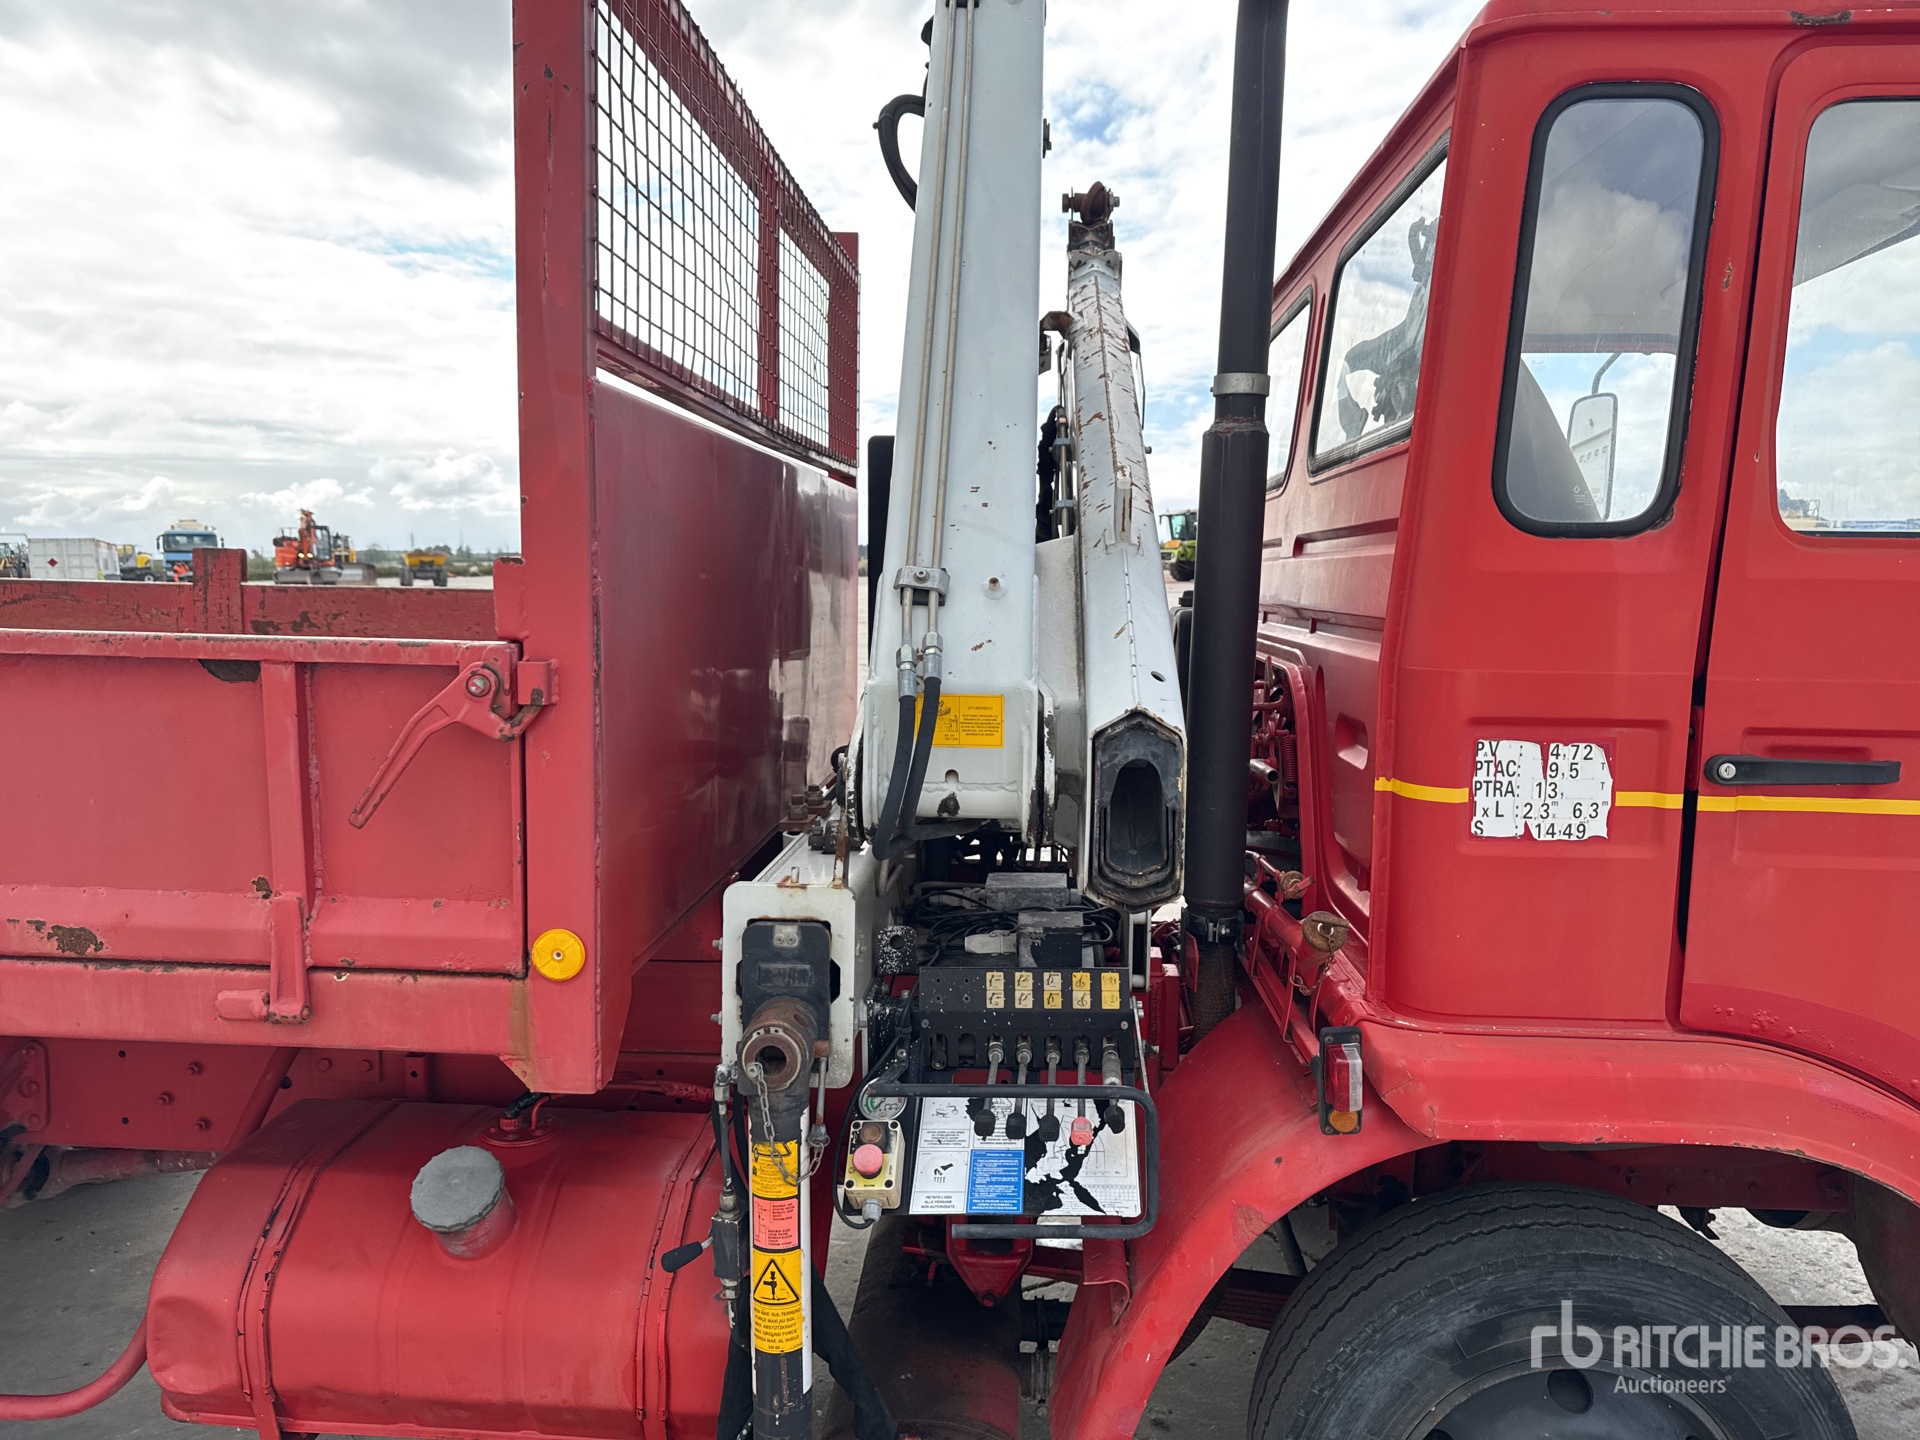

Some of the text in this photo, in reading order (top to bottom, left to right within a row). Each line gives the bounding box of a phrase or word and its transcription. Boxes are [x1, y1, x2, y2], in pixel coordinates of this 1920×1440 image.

[1550, 743, 1593, 760] 4,72
[1548, 761, 1579, 780] 9,5
[1535, 823, 1587, 839] 14,49
